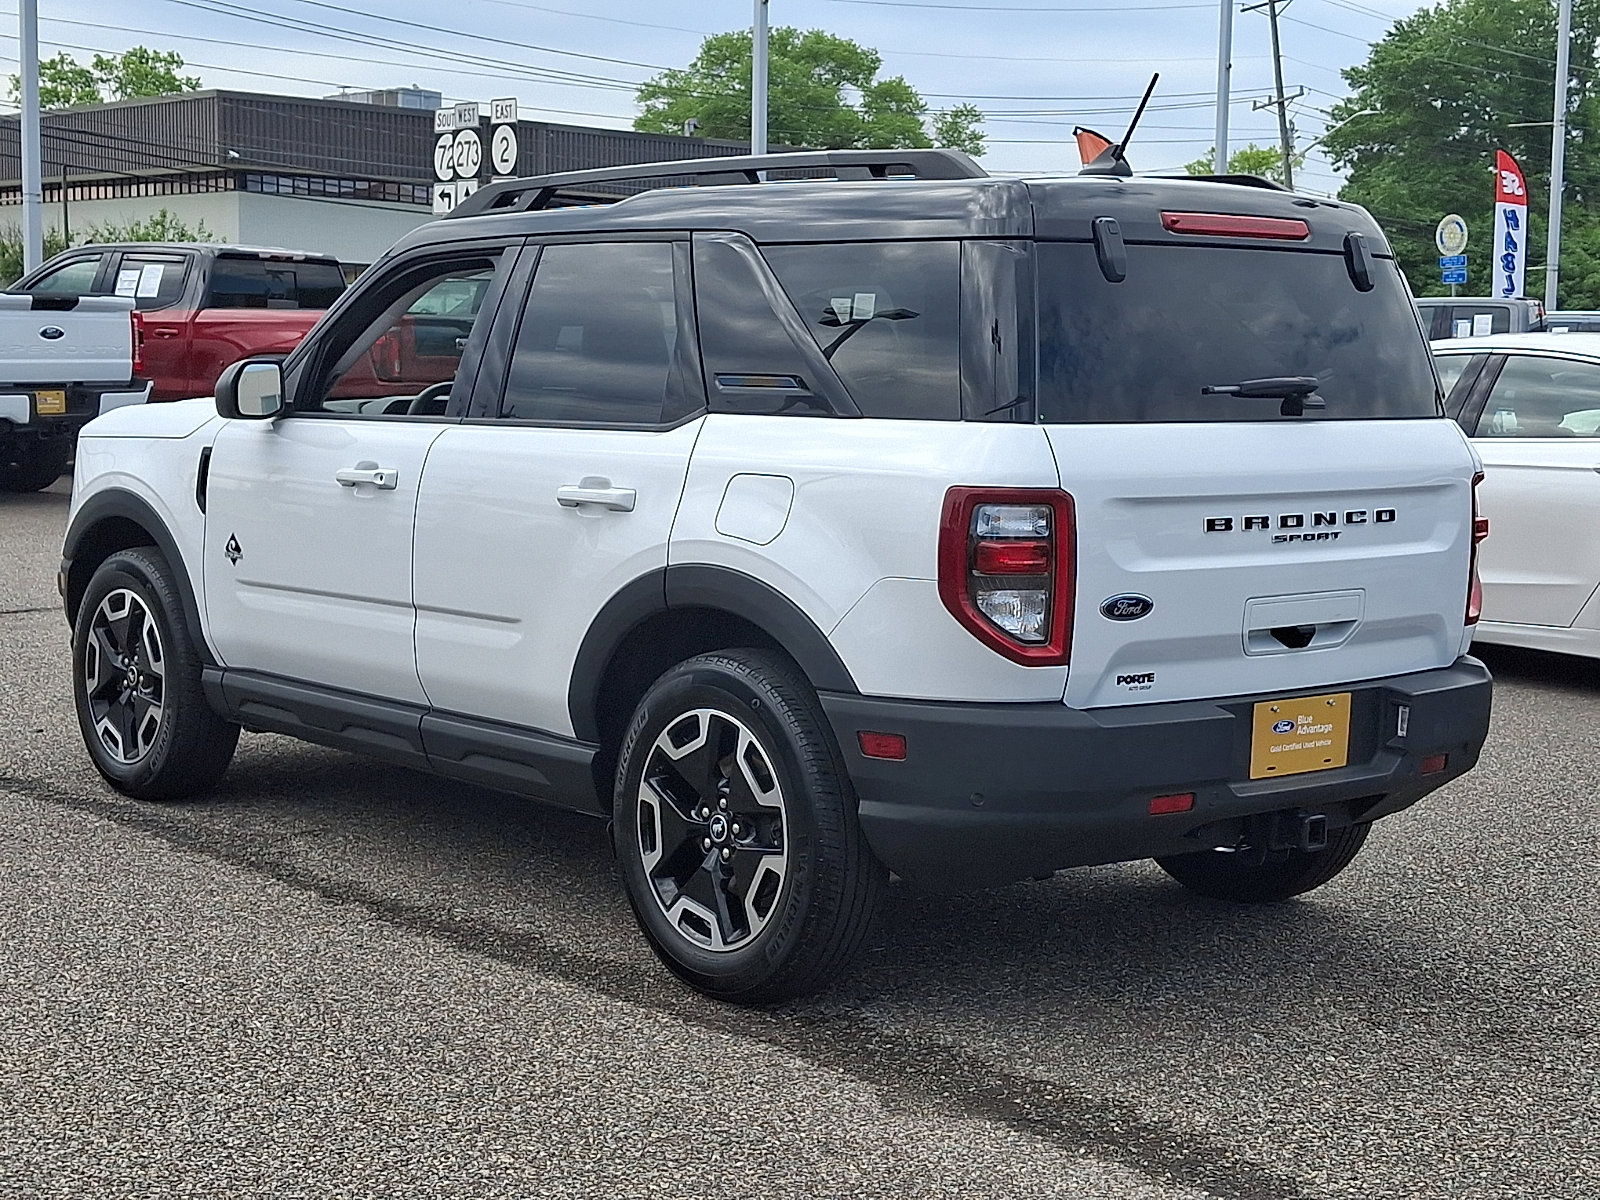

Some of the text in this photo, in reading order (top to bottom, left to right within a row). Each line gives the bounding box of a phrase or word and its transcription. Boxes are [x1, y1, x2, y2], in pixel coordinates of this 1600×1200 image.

[458, 108, 476, 122] WEST
[495, 104, 512, 119] EAST
[437, 112, 455, 128] SOUT
[438, 144, 454, 171] 72
[456, 140, 480, 168] 273
[500, 136, 510, 164] 2
[1203, 507, 1398, 533] BRONCO
[1271, 530, 1342, 544] SPORT
[1112, 599, 1143, 616] Ford
[1116, 672, 1155, 686] PORTE
[1297, 714, 1314, 725] Blue
[1296, 722, 1333, 736] Advantage
[1270, 744, 1282, 753] Gold
